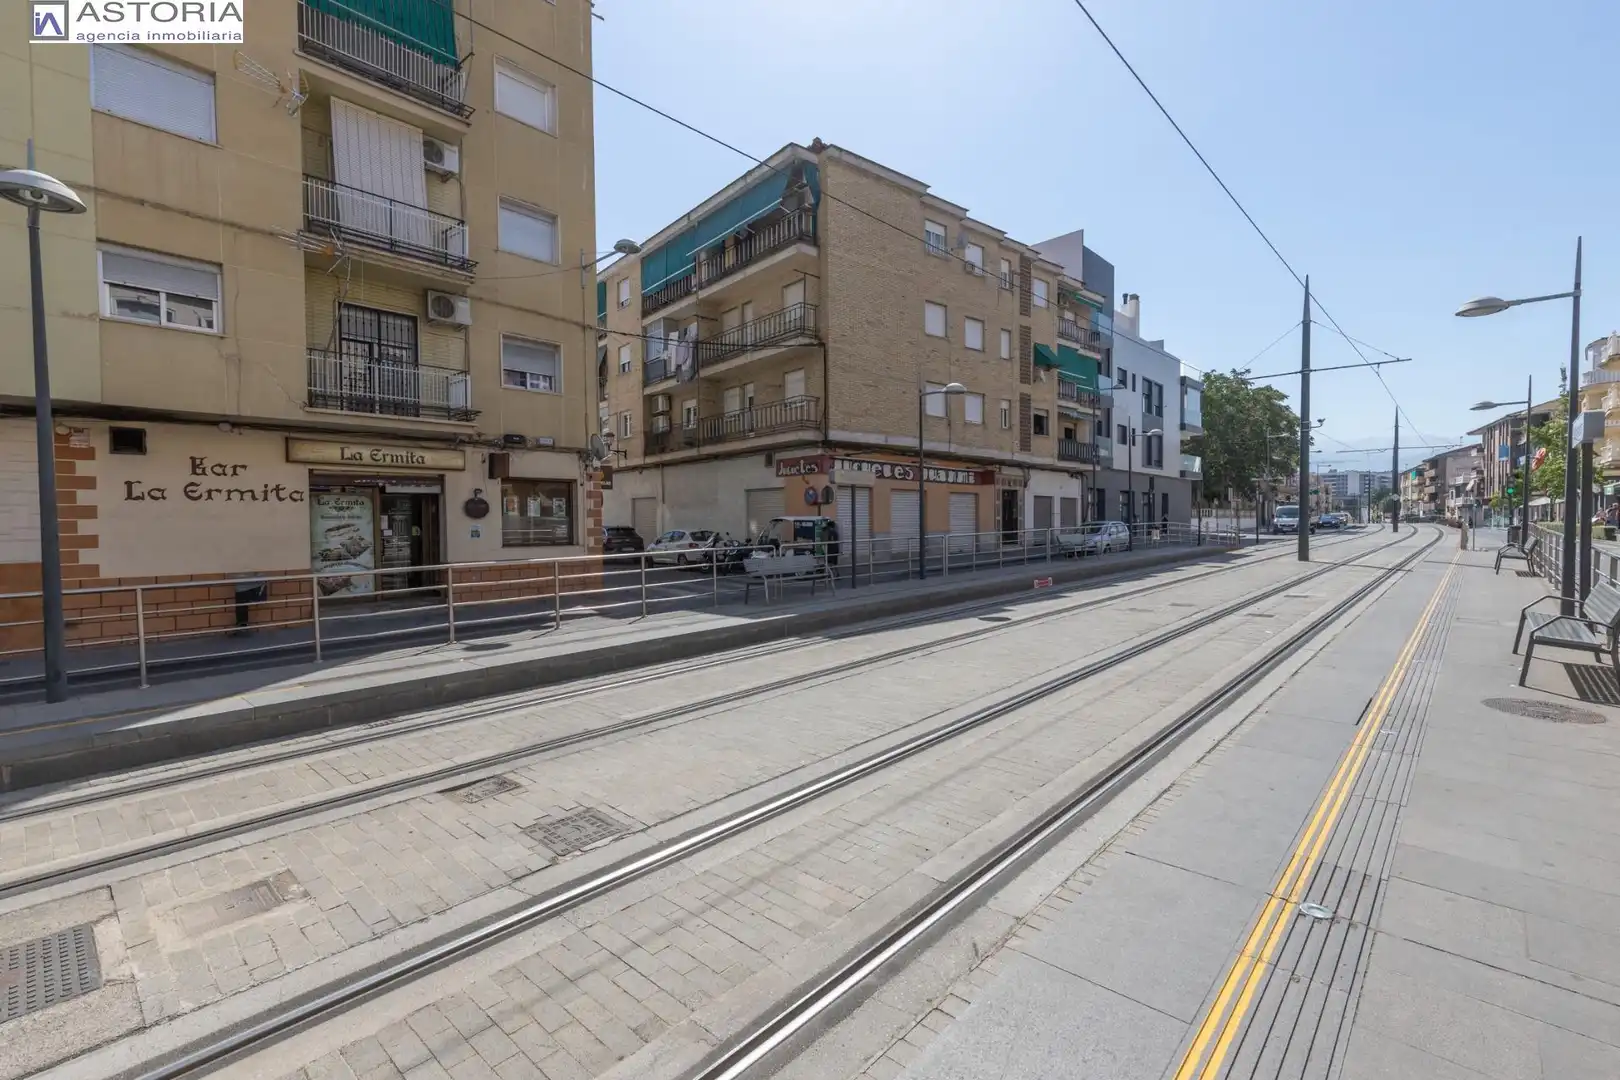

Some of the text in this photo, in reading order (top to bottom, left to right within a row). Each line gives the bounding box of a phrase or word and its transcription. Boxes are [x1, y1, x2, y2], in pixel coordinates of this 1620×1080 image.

[339, 446, 426, 465] La Ermita
[189, 456, 248, 477] Bar
[124, 480, 305, 503] La Ermita
